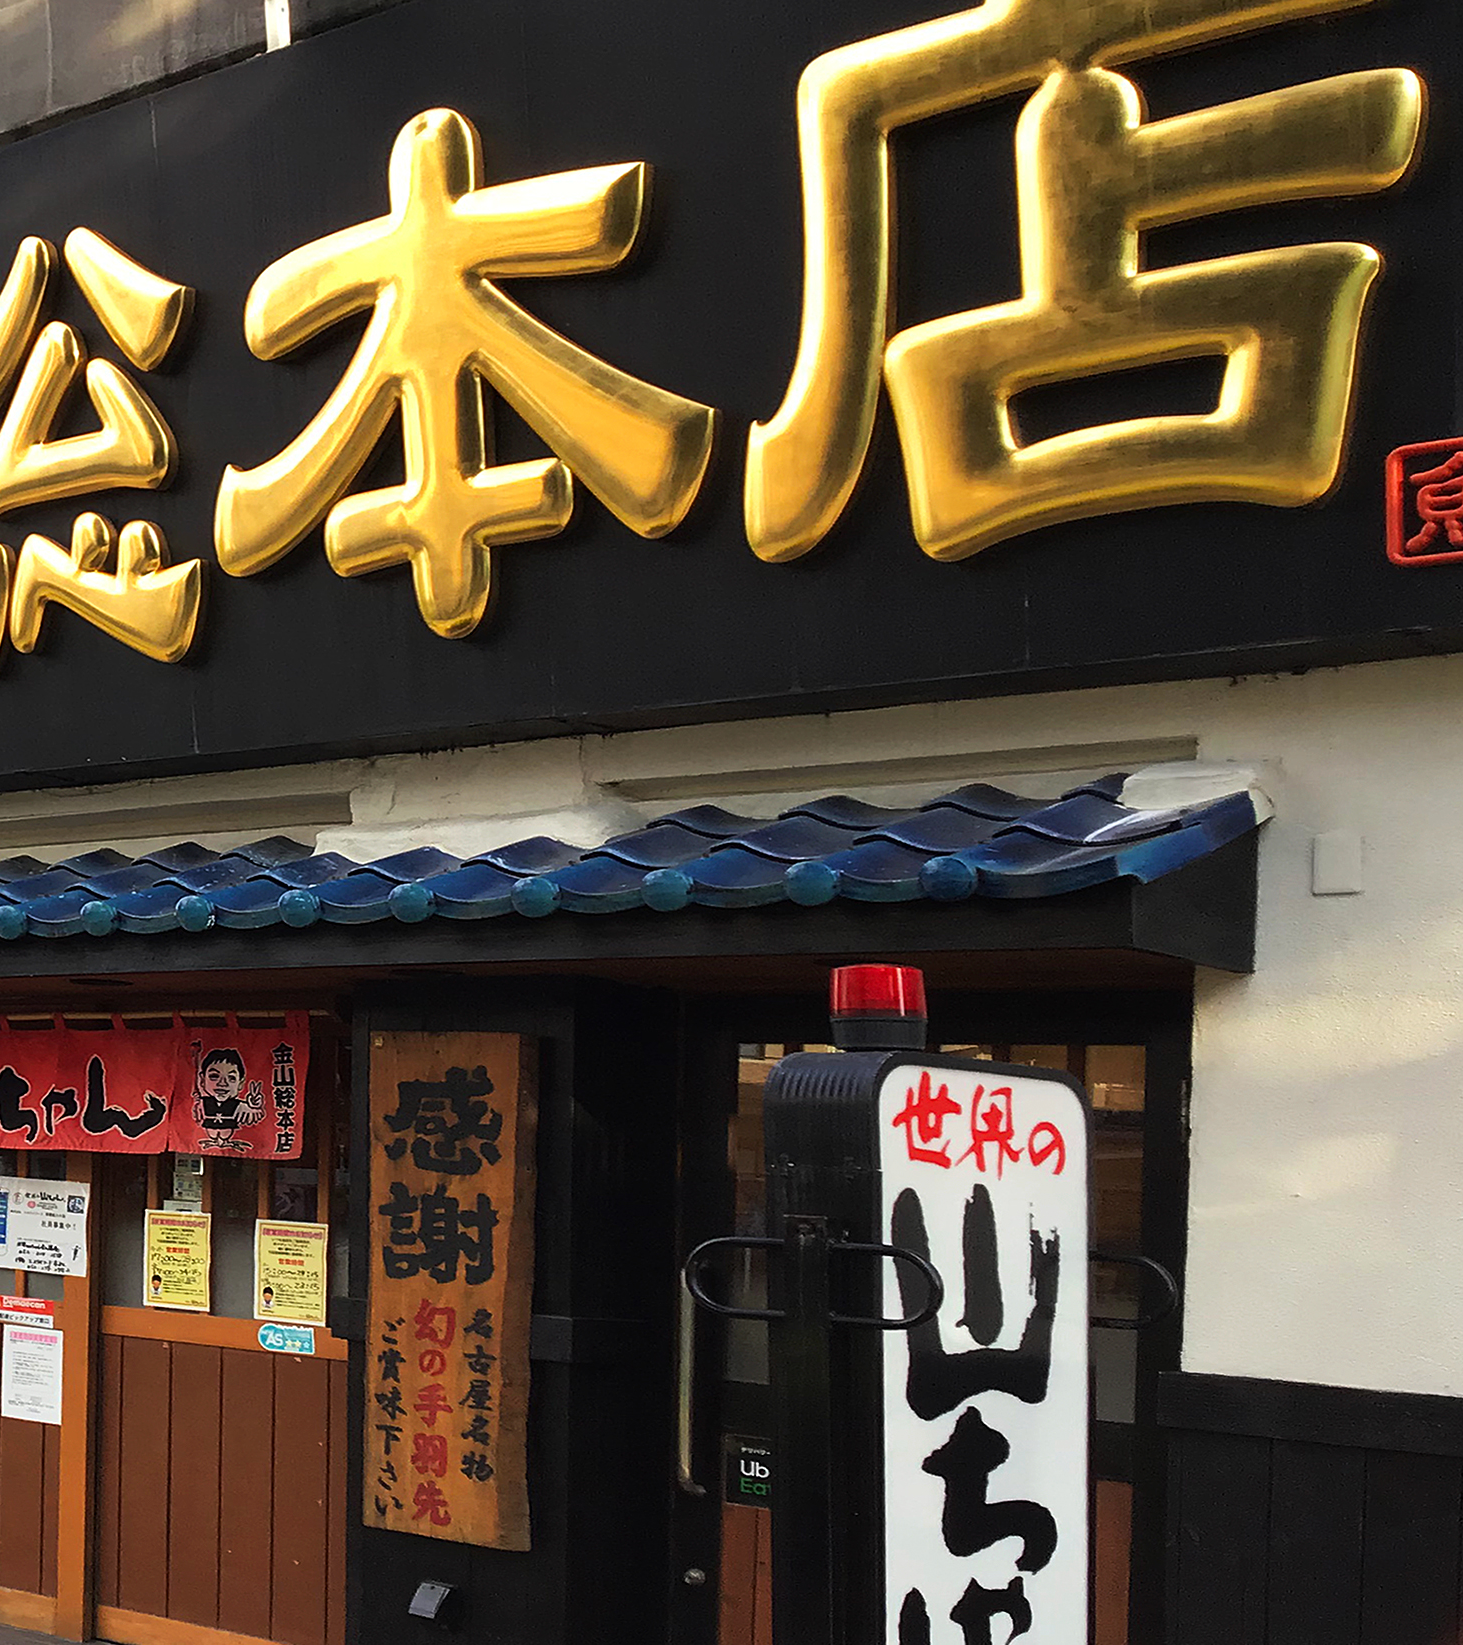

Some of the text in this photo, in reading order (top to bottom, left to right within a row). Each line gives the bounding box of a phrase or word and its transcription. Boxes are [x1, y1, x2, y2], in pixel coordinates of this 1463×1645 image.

[271, 1041, 295, 1155] 金山総本店
[378, 1065, 503, 1286] 感謝
[892, 1071, 1067, 1181] 世界の
[374, 1316, 408, 1517] ご賞味下さい
[411, 1299, 457, 1527] 幻の手羽先
[459, 1308, 497, 1483] 名古屋名物
[740, 1459, 770, 1479] Ub
[891, 1183, 1061, 1645] 山ちゃ
